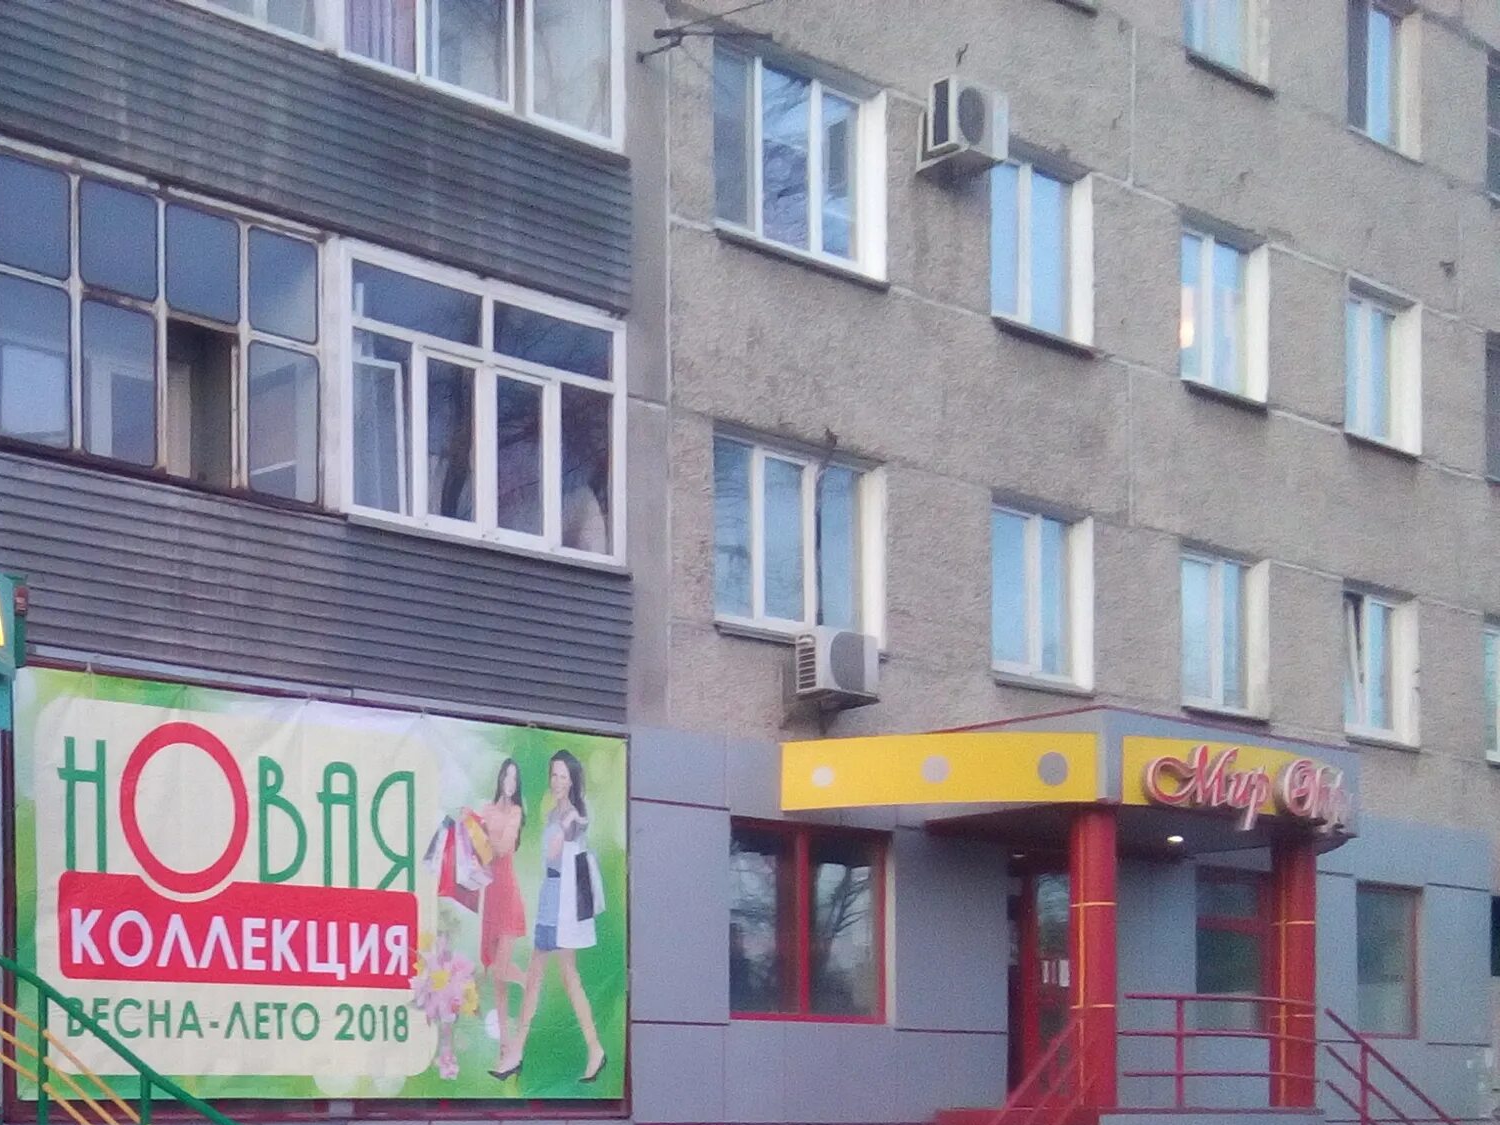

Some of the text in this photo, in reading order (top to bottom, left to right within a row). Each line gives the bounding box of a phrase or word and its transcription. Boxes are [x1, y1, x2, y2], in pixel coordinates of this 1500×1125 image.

[57, 720, 416, 894] НОВАЯ
[1145, 743, 1270, 831] Мир
[69, 907, 409, 982] КОЛЛЕКЦИЯ
[334, 1002, 410, 1044] 2018
